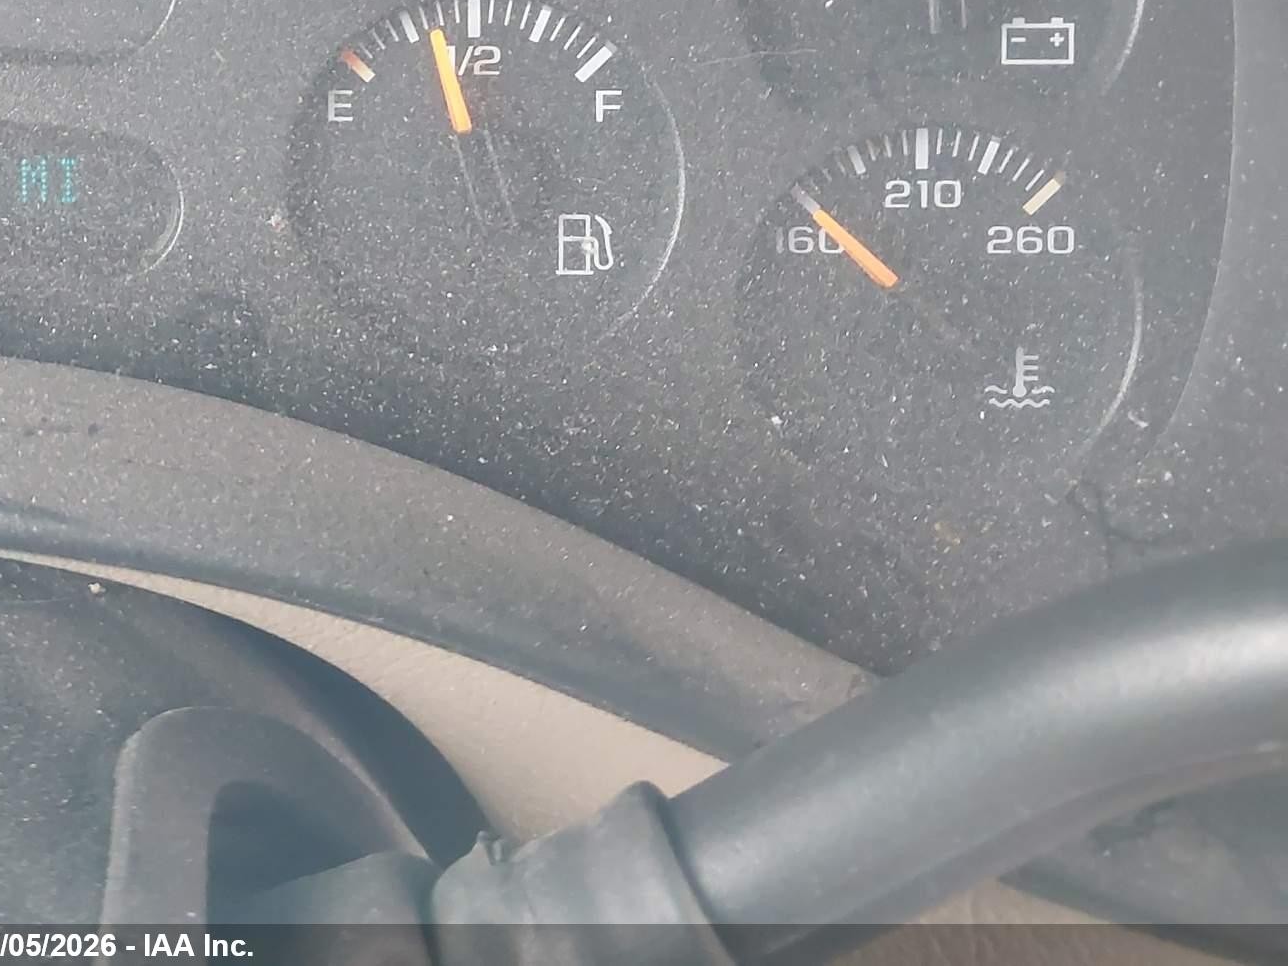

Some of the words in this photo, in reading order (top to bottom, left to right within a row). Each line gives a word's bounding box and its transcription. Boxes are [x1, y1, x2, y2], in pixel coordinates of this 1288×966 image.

[445, 45, 501, 76] 1/2
[327, 89, 354, 122] E
[595, 89, 623, 123] F
[17, 157, 77, 204] MI
[883, 180, 962, 209] 210
[986, 225, 1075, 254] 260
